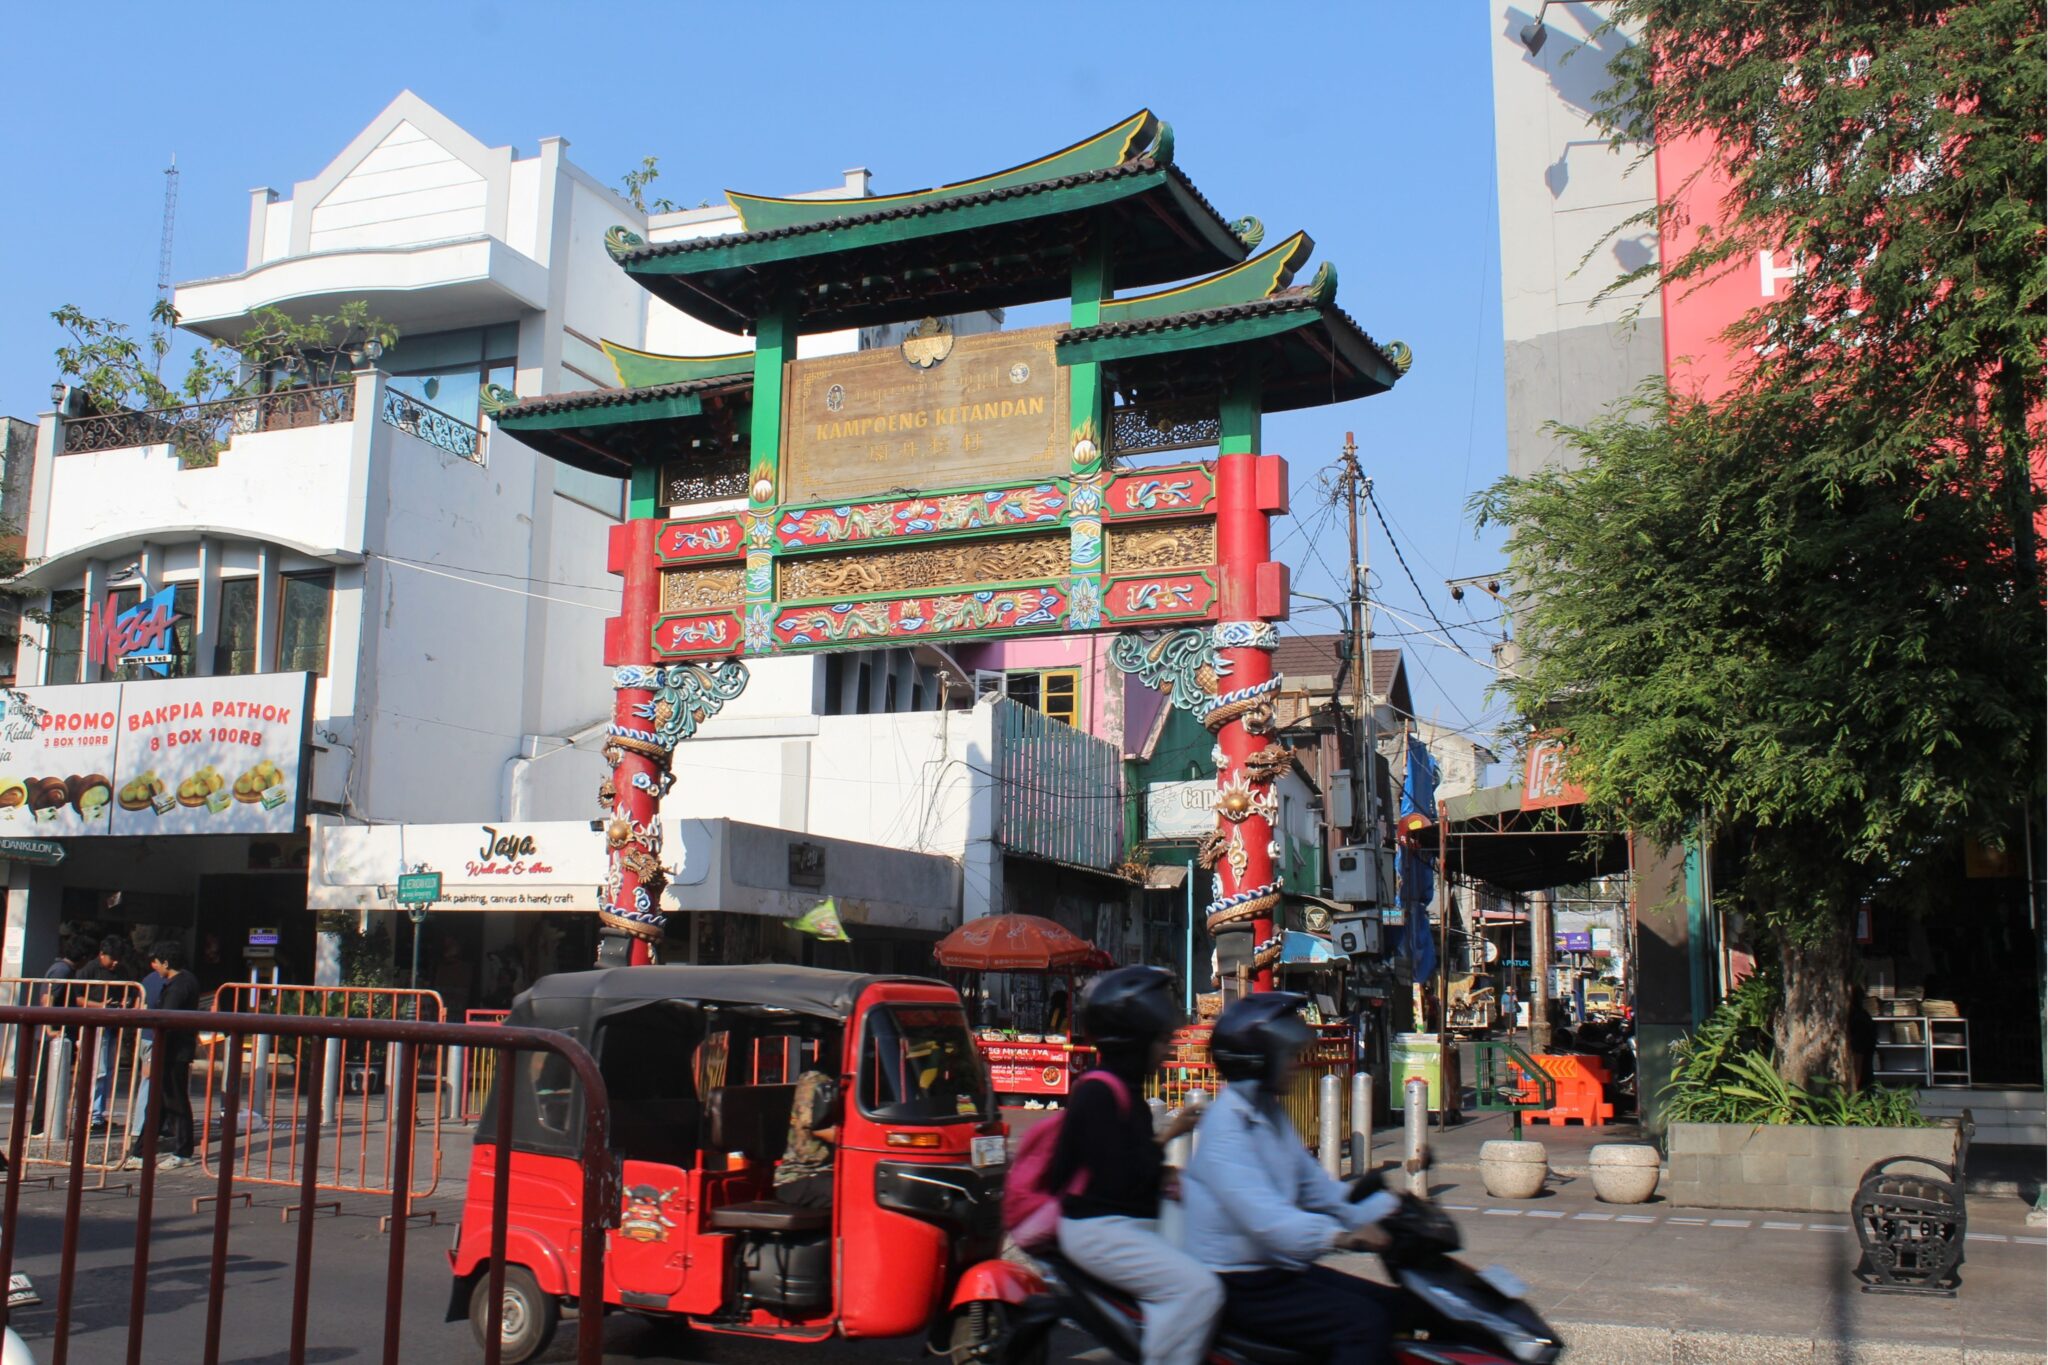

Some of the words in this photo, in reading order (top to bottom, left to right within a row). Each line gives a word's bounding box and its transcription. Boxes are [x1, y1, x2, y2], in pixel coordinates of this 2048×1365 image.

[816, 411, 928, 441] KAMPOENG
[935, 396, 1044, 426] KETANDAN
[41, 711, 115, 732] PROMO
[128, 701, 204, 731] BAKPIA
[212, 700, 291, 724] PATHOK
[5, 721, 35, 742] Kidul
[44, 738, 50, 748] 3
[53, 736, 74, 747] BOX
[78, 735, 109, 746] 100RB
[150, 736, 160, 751] 8
[167, 728, 202, 747] BOX
[208, 727, 263, 747] 100RB
[480, 825, 537, 862] Jaya
[465, 860, 497, 877] Wall
[512, 860, 526, 875] &
[490, 895, 517, 904] canvas
[518, 893, 526, 904] &
[527, 893, 552, 905] handy
[554, 893, 574, 903] craft
